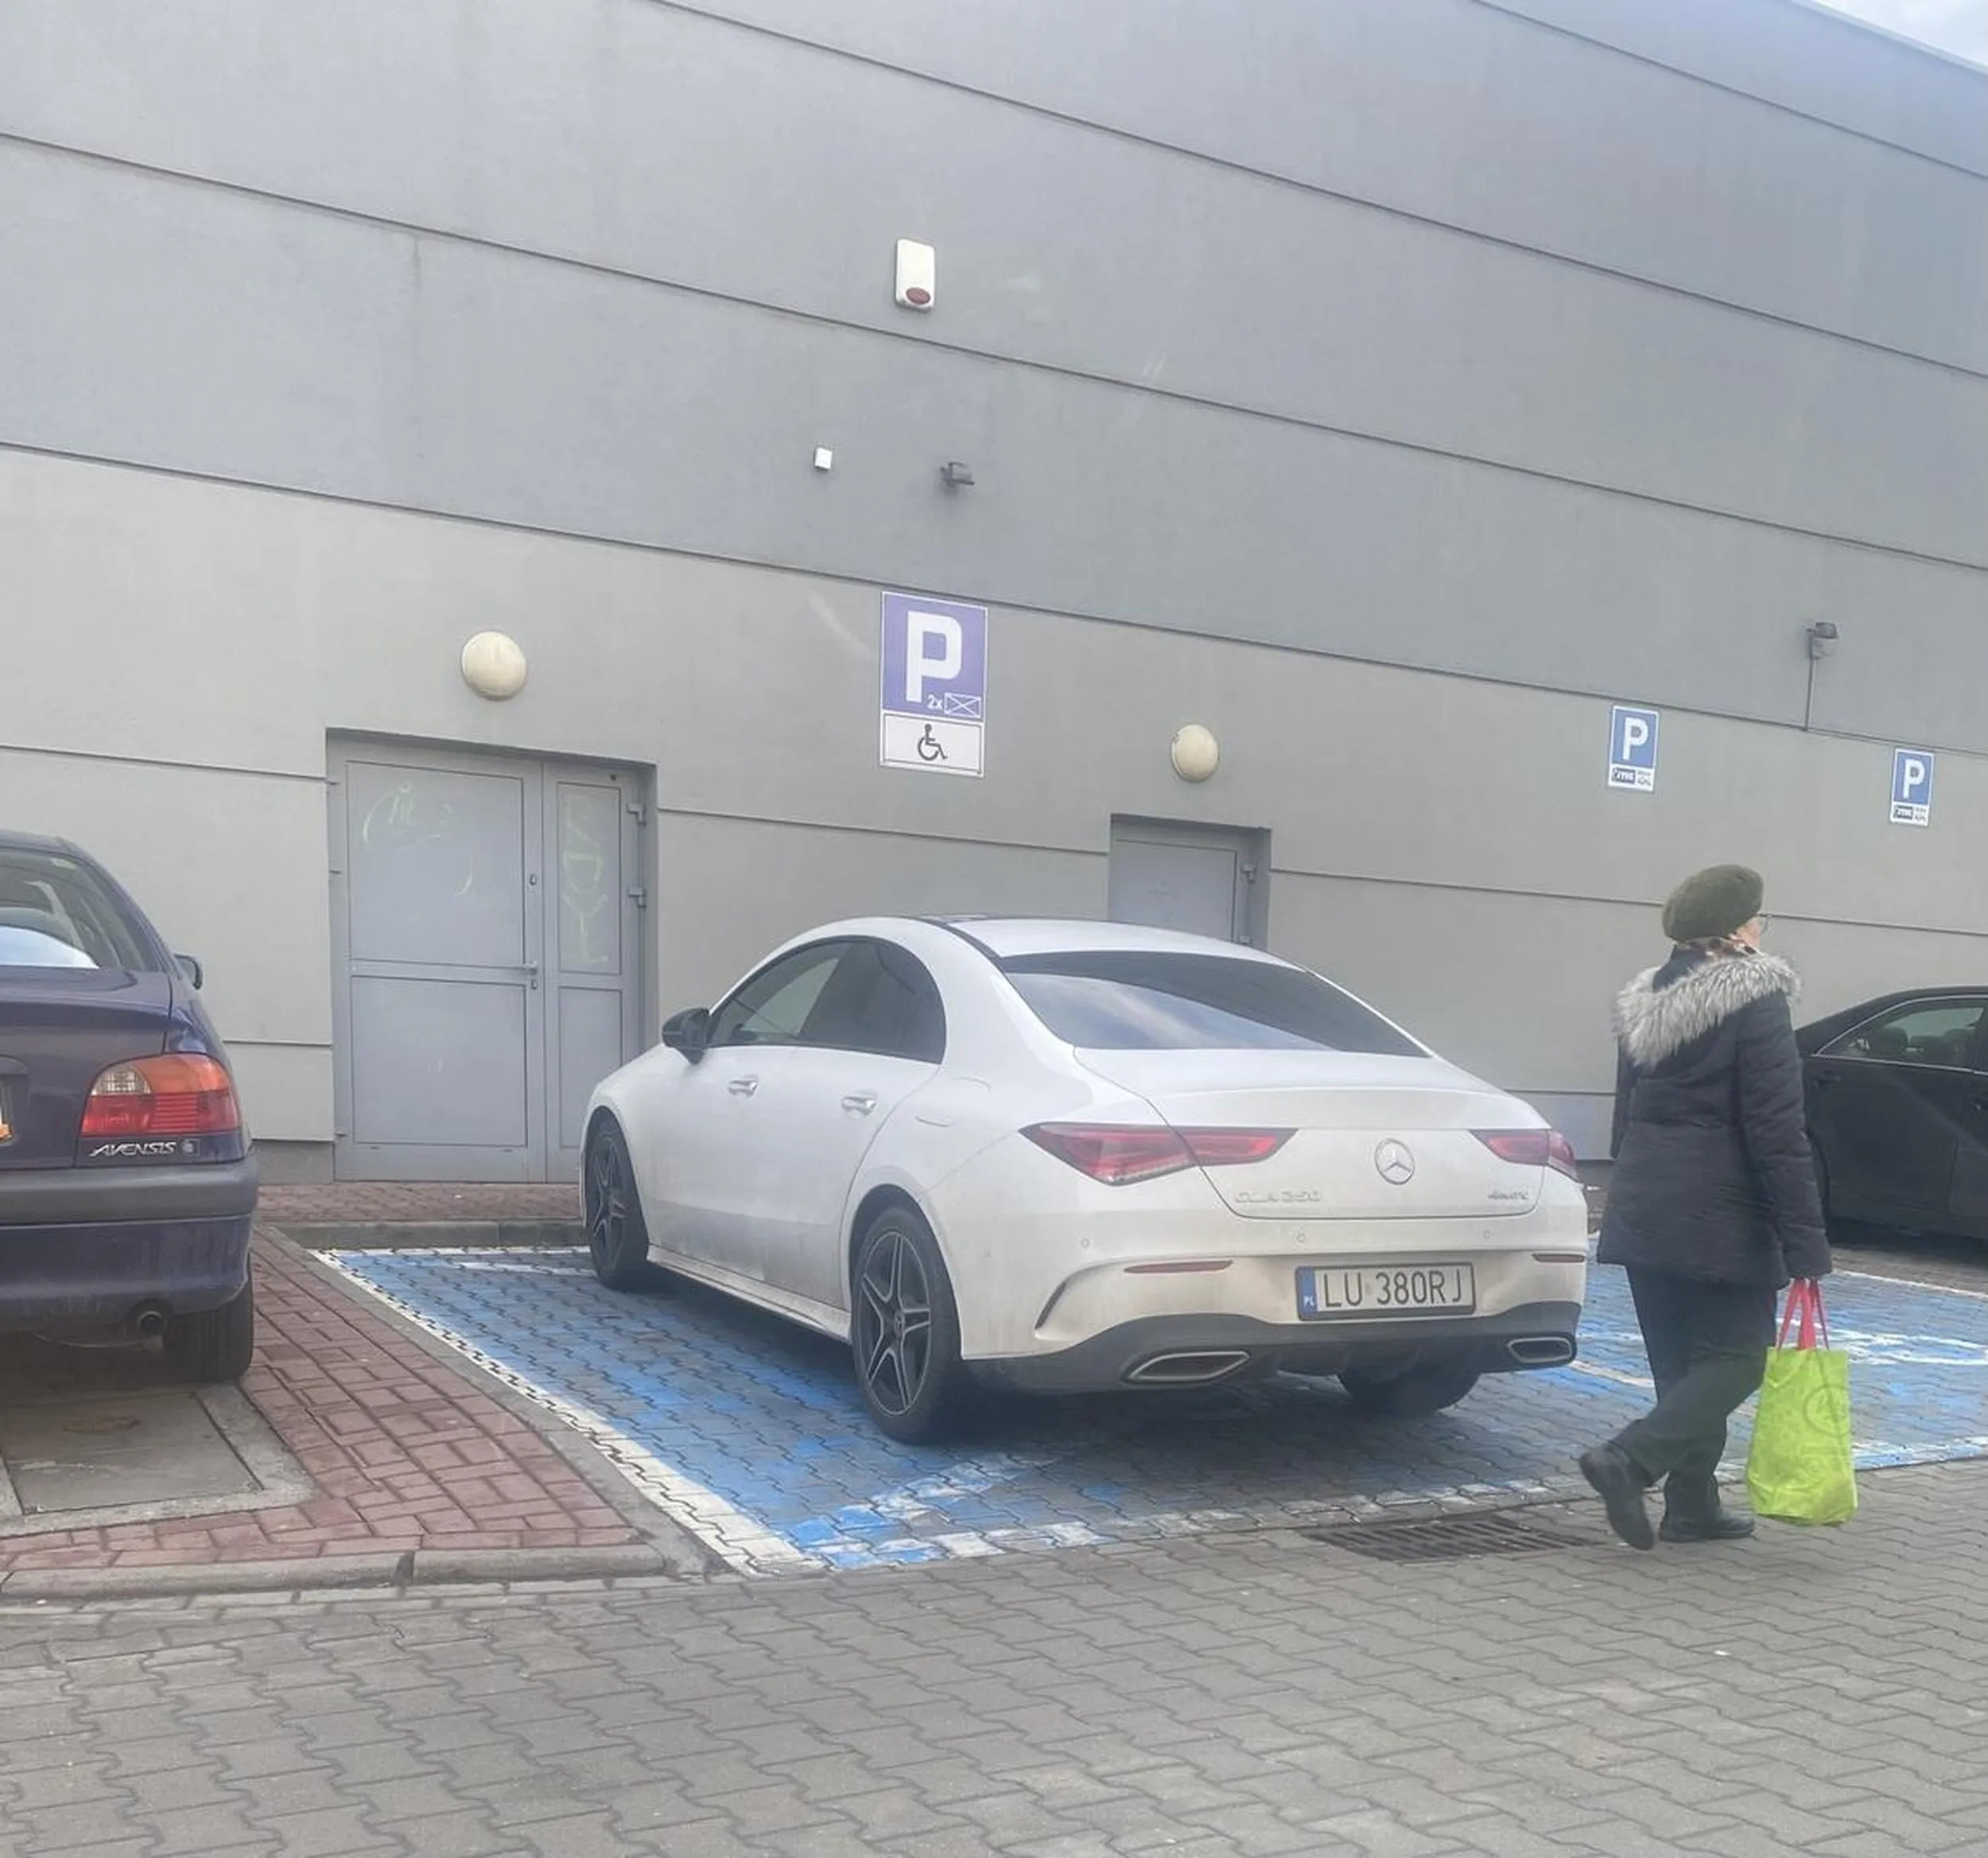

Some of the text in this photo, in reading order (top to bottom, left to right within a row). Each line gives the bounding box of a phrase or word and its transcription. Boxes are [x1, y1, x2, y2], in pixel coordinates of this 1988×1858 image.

[906, 610, 962, 702] P
[926, 694, 943, 709] 2x
[1623, 717, 1648, 760] P
[1903, 758, 1924, 799] P
[88, 1141, 177, 1157] AVENSIS
[1323, 1269, 1462, 1308] LU 380RJ
